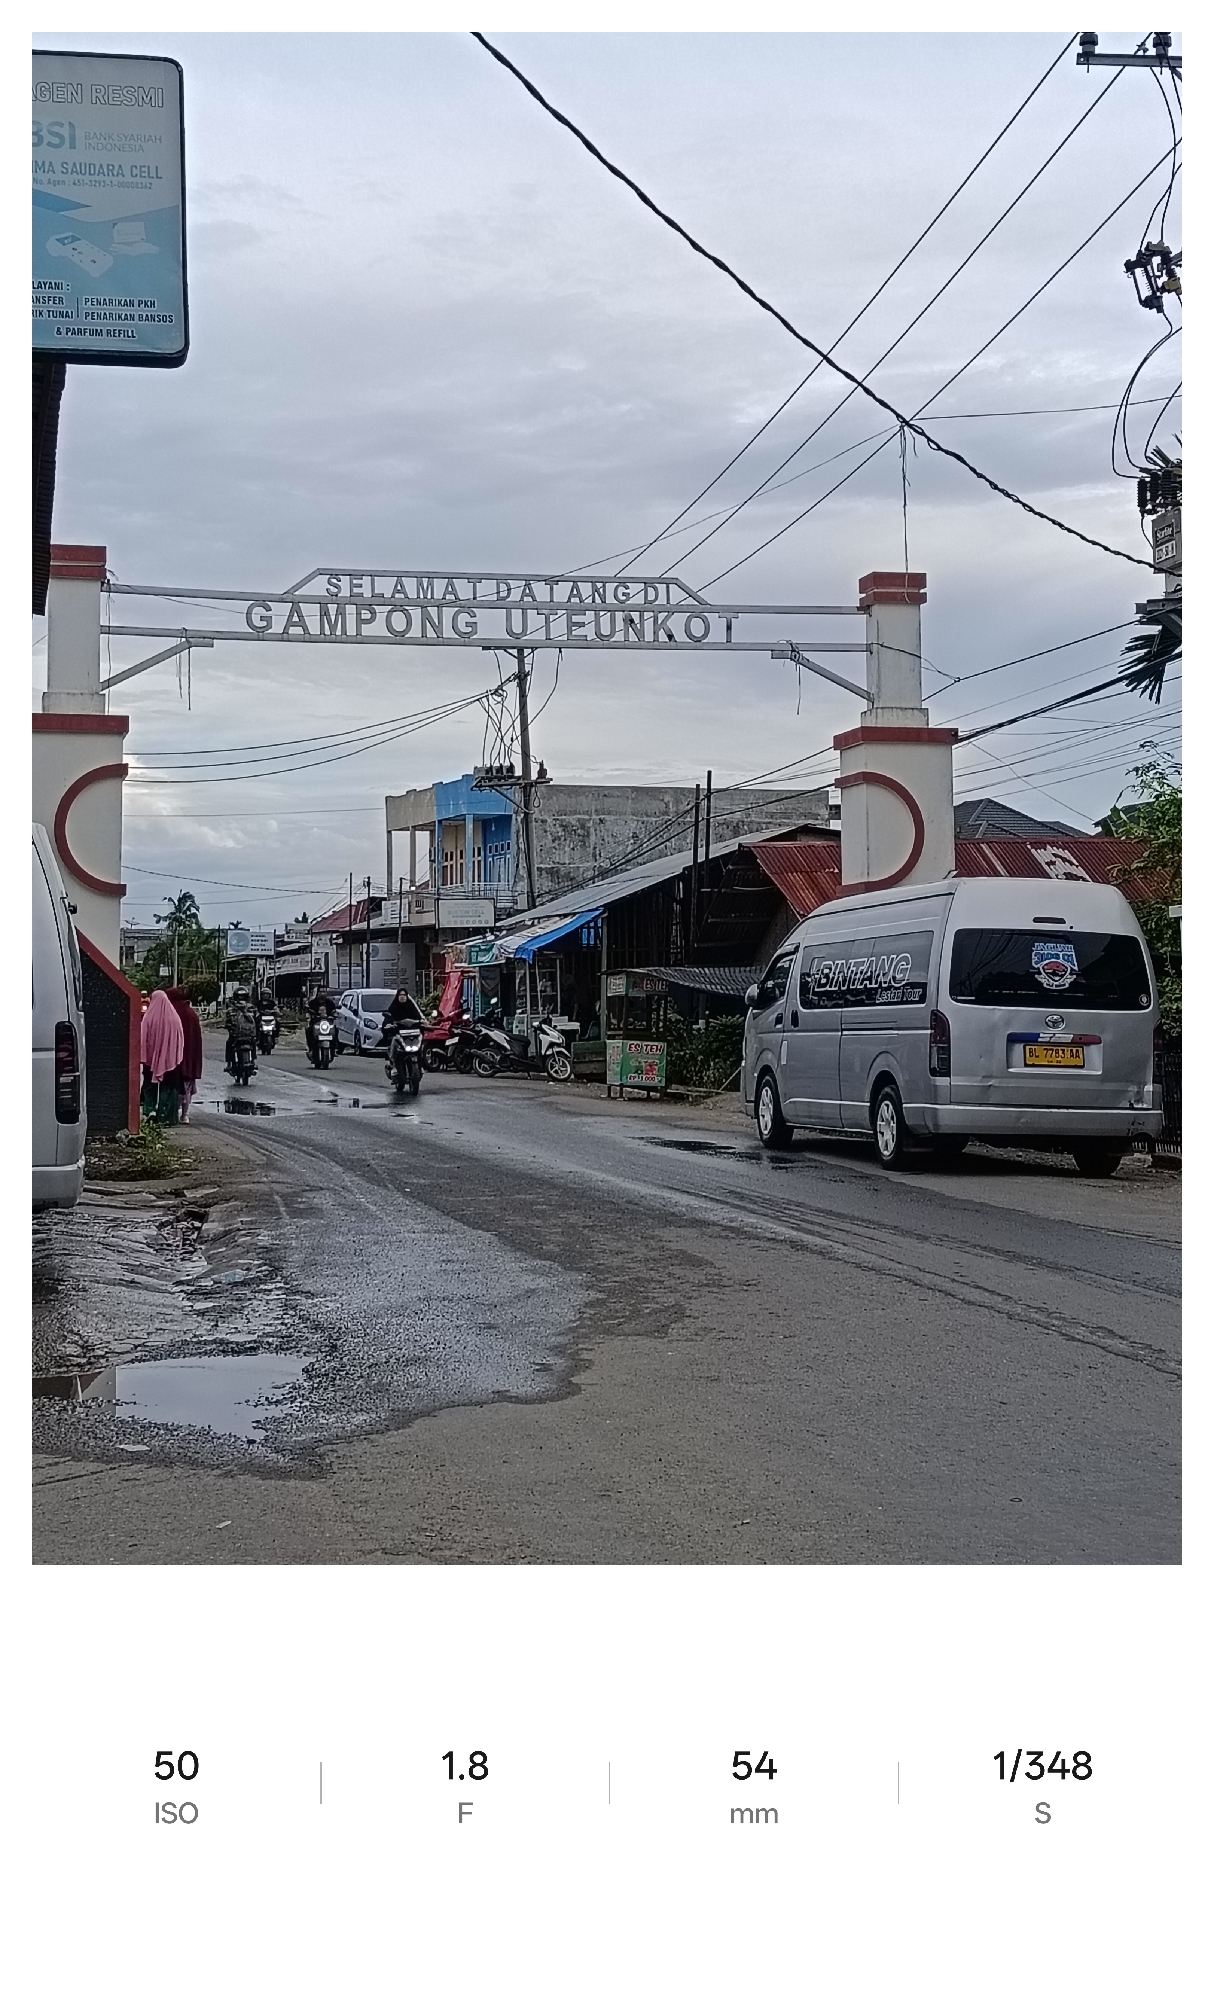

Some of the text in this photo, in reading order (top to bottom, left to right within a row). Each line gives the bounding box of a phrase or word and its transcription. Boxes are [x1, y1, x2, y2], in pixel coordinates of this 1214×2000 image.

[91, 84, 164, 108] RESMI
[32, 121, 77, 150] BSI
[84, 131, 163, 144] BANK SYARIAH
[84, 143, 145, 153] INDONESIA
[60, 161, 126, 177] SAUDARA
[130, 164, 163, 179] CELL
[47, 178, 66, 187] Agen
[32, 280, 63, 291] LAYANI
[84, 297, 156, 309] PENARIKAN PKH
[46, 309, 74, 319] TUNAI
[84, 311, 174, 324] PENARIKAN BANSOS
[55, 326, 137, 339] & PARFUM REFILL
[325, 573, 671, 606] SELAMAT DATANG DI
[245, 600, 740, 644] GAMPONG UTEUNKOT
[814, 953, 912, 992] BINTANG
[644, 977, 655, 991] ES
[904, 986, 923, 1001] Tour
[627, 1042, 663, 1055] ES TEH
[1028, 1047, 1040, 1059] BL
[1069, 1048, 1081, 1060] AA
